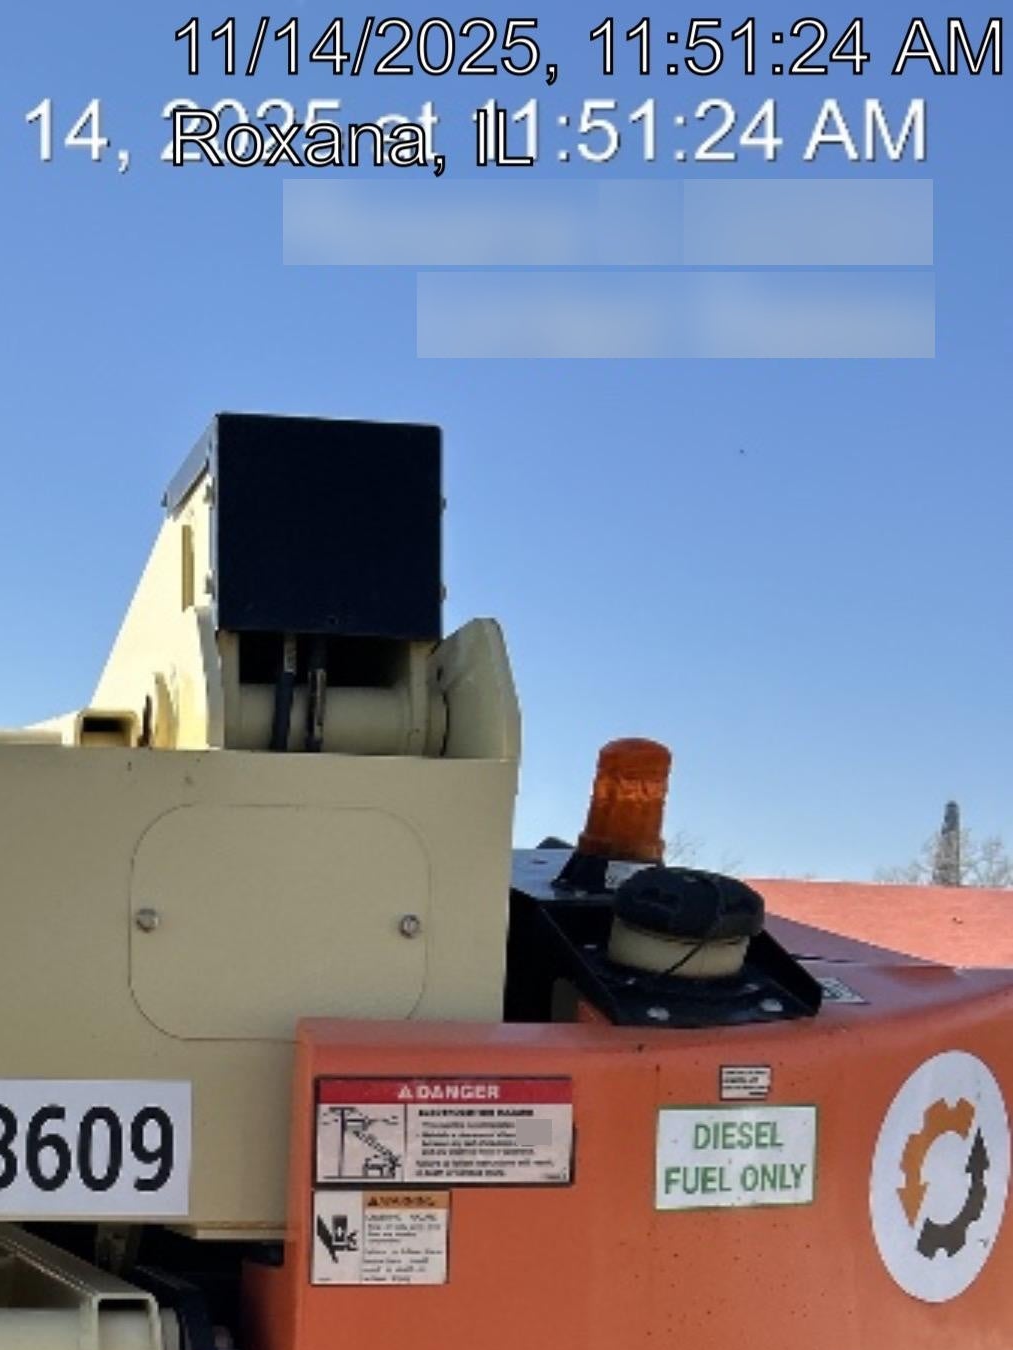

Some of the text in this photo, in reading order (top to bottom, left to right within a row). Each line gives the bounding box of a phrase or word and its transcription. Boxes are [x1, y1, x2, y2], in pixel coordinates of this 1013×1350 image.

[415, 1084, 501, 1100] DANGER
[693, 1120, 784, 1150] DIESEL
[664, 1163, 806, 1195] FUEL ONLY
